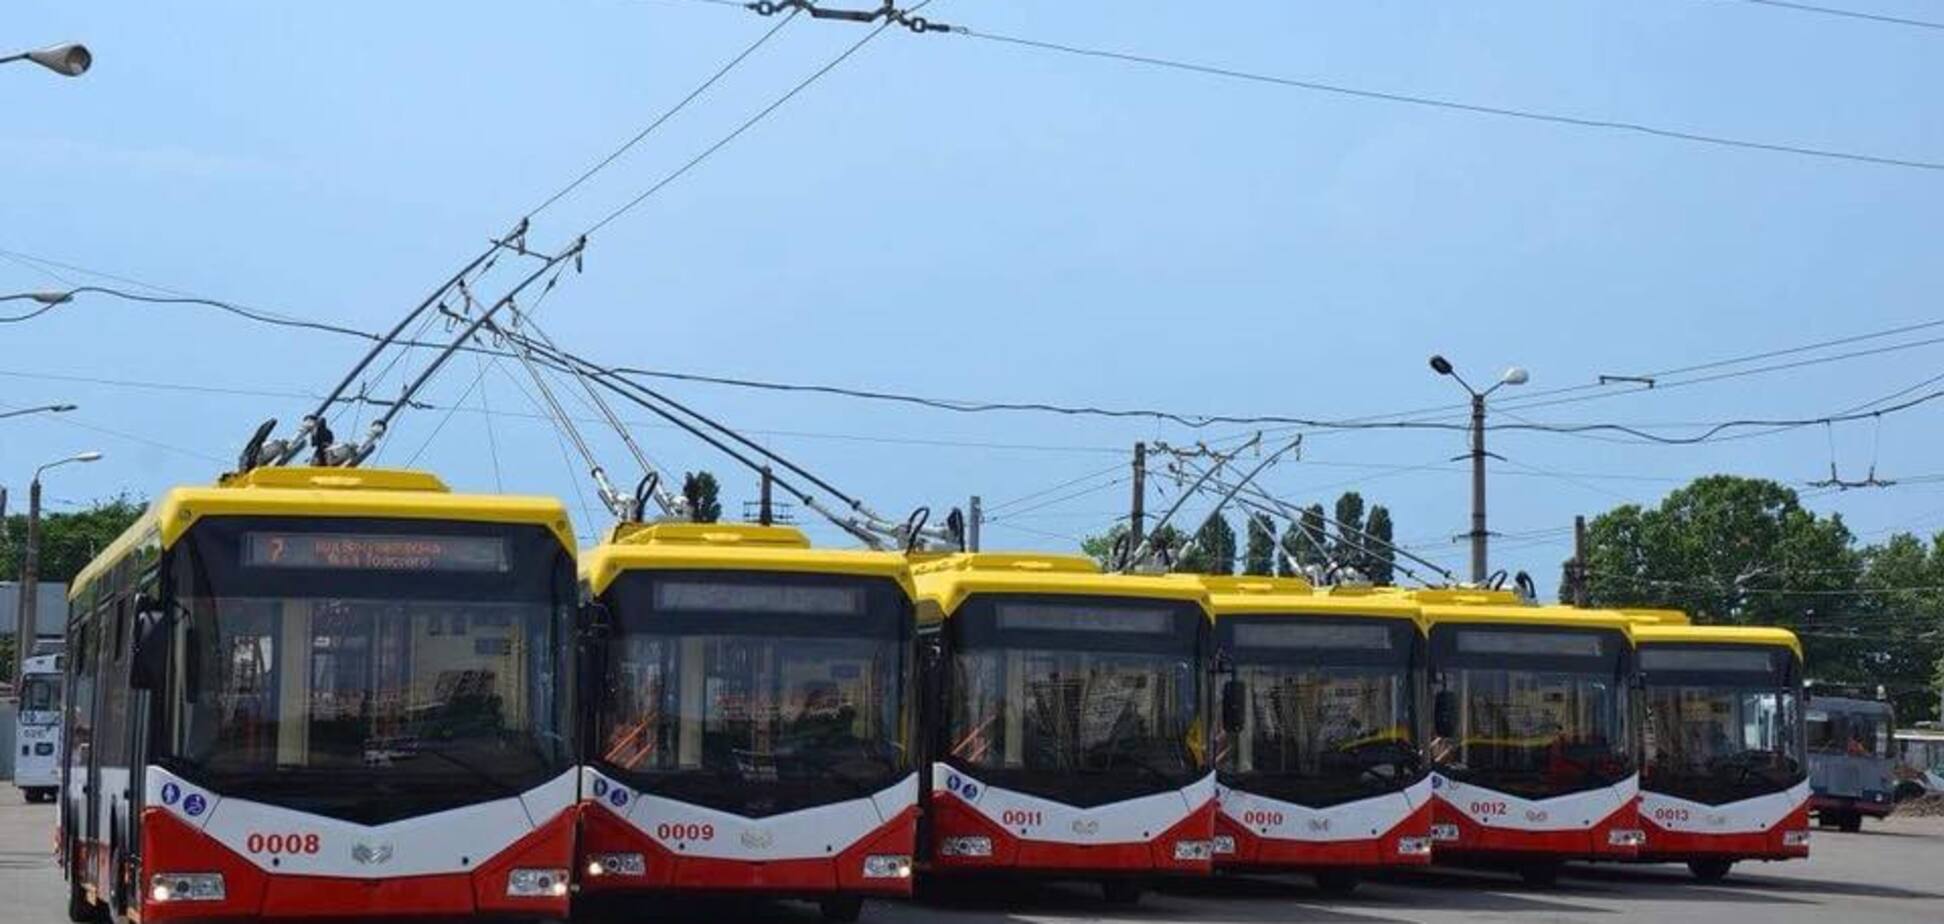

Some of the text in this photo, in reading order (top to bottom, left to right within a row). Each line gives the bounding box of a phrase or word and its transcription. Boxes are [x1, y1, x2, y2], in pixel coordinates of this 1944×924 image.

[1470, 801, 1506, 816] 0012
[1655, 808, 1688, 821] 0013
[1003, 811, 1042, 826] 0011
[1245, 810, 1283, 825] 0010
[657, 823, 714, 840] 0009
[247, 833, 320, 854] 0008
